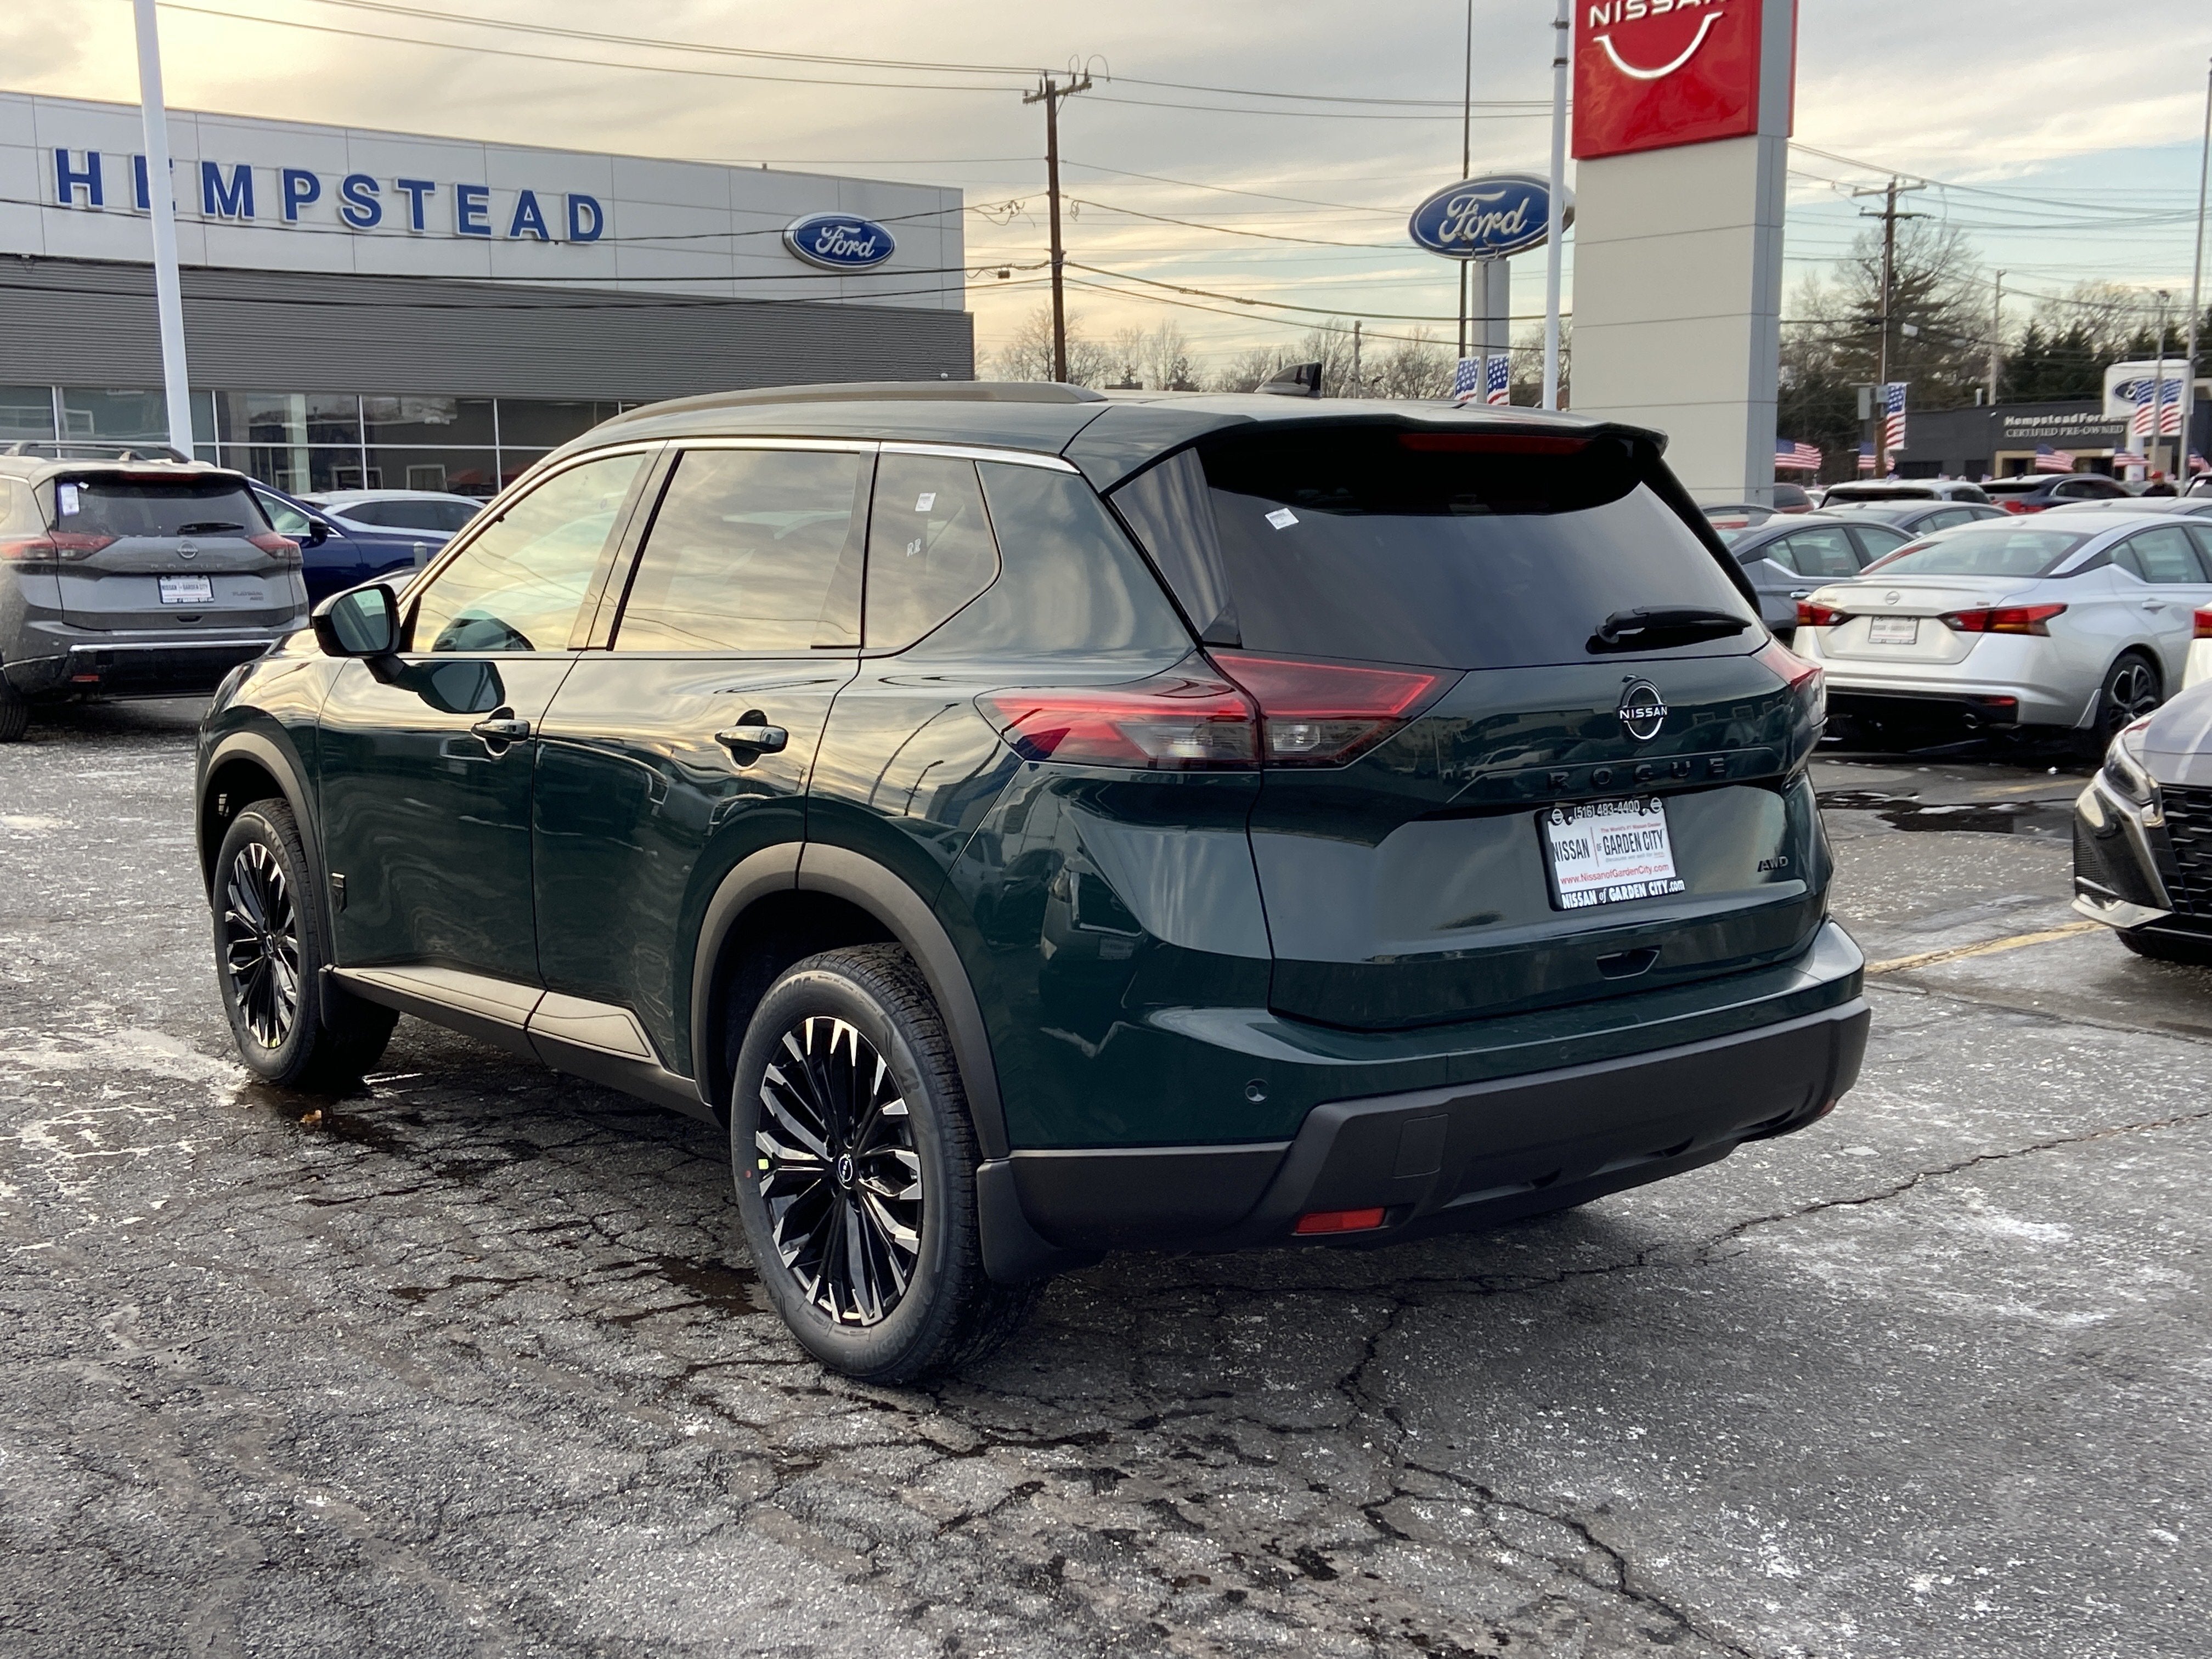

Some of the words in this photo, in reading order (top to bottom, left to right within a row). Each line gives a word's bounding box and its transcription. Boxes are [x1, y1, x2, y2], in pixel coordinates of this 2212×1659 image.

[1589, 0, 1726, 28] NISS
[1438, 190, 1530, 243] Ford
[815, 225, 876, 258] Ford
[2004, 414, 2078, 427] Hempstead
[2006, 427, 2057, 437] CERTIFIED
[1619, 706, 1668, 719] NISSAN
[1548, 757, 1725, 789] ROGUE
[1573, 806, 1595, 819] (516)
[1597, 800, 1640, 816] 483-4400
[1553, 838, 1590, 863] NISSAN
[1602, 832, 1643, 856] GARDEN
[1642, 829, 1663, 851] CITY
[1560, 864, 1669, 885] www.NissanofGardenCity.com
[1757, 856, 1788, 872] AWD
[1561, 889, 1598, 910] NISSAN
[1599, 888, 1607, 904] of
[1609, 883, 1646, 902] GARDEN
[1648, 879, 1685, 896] CITY.com
